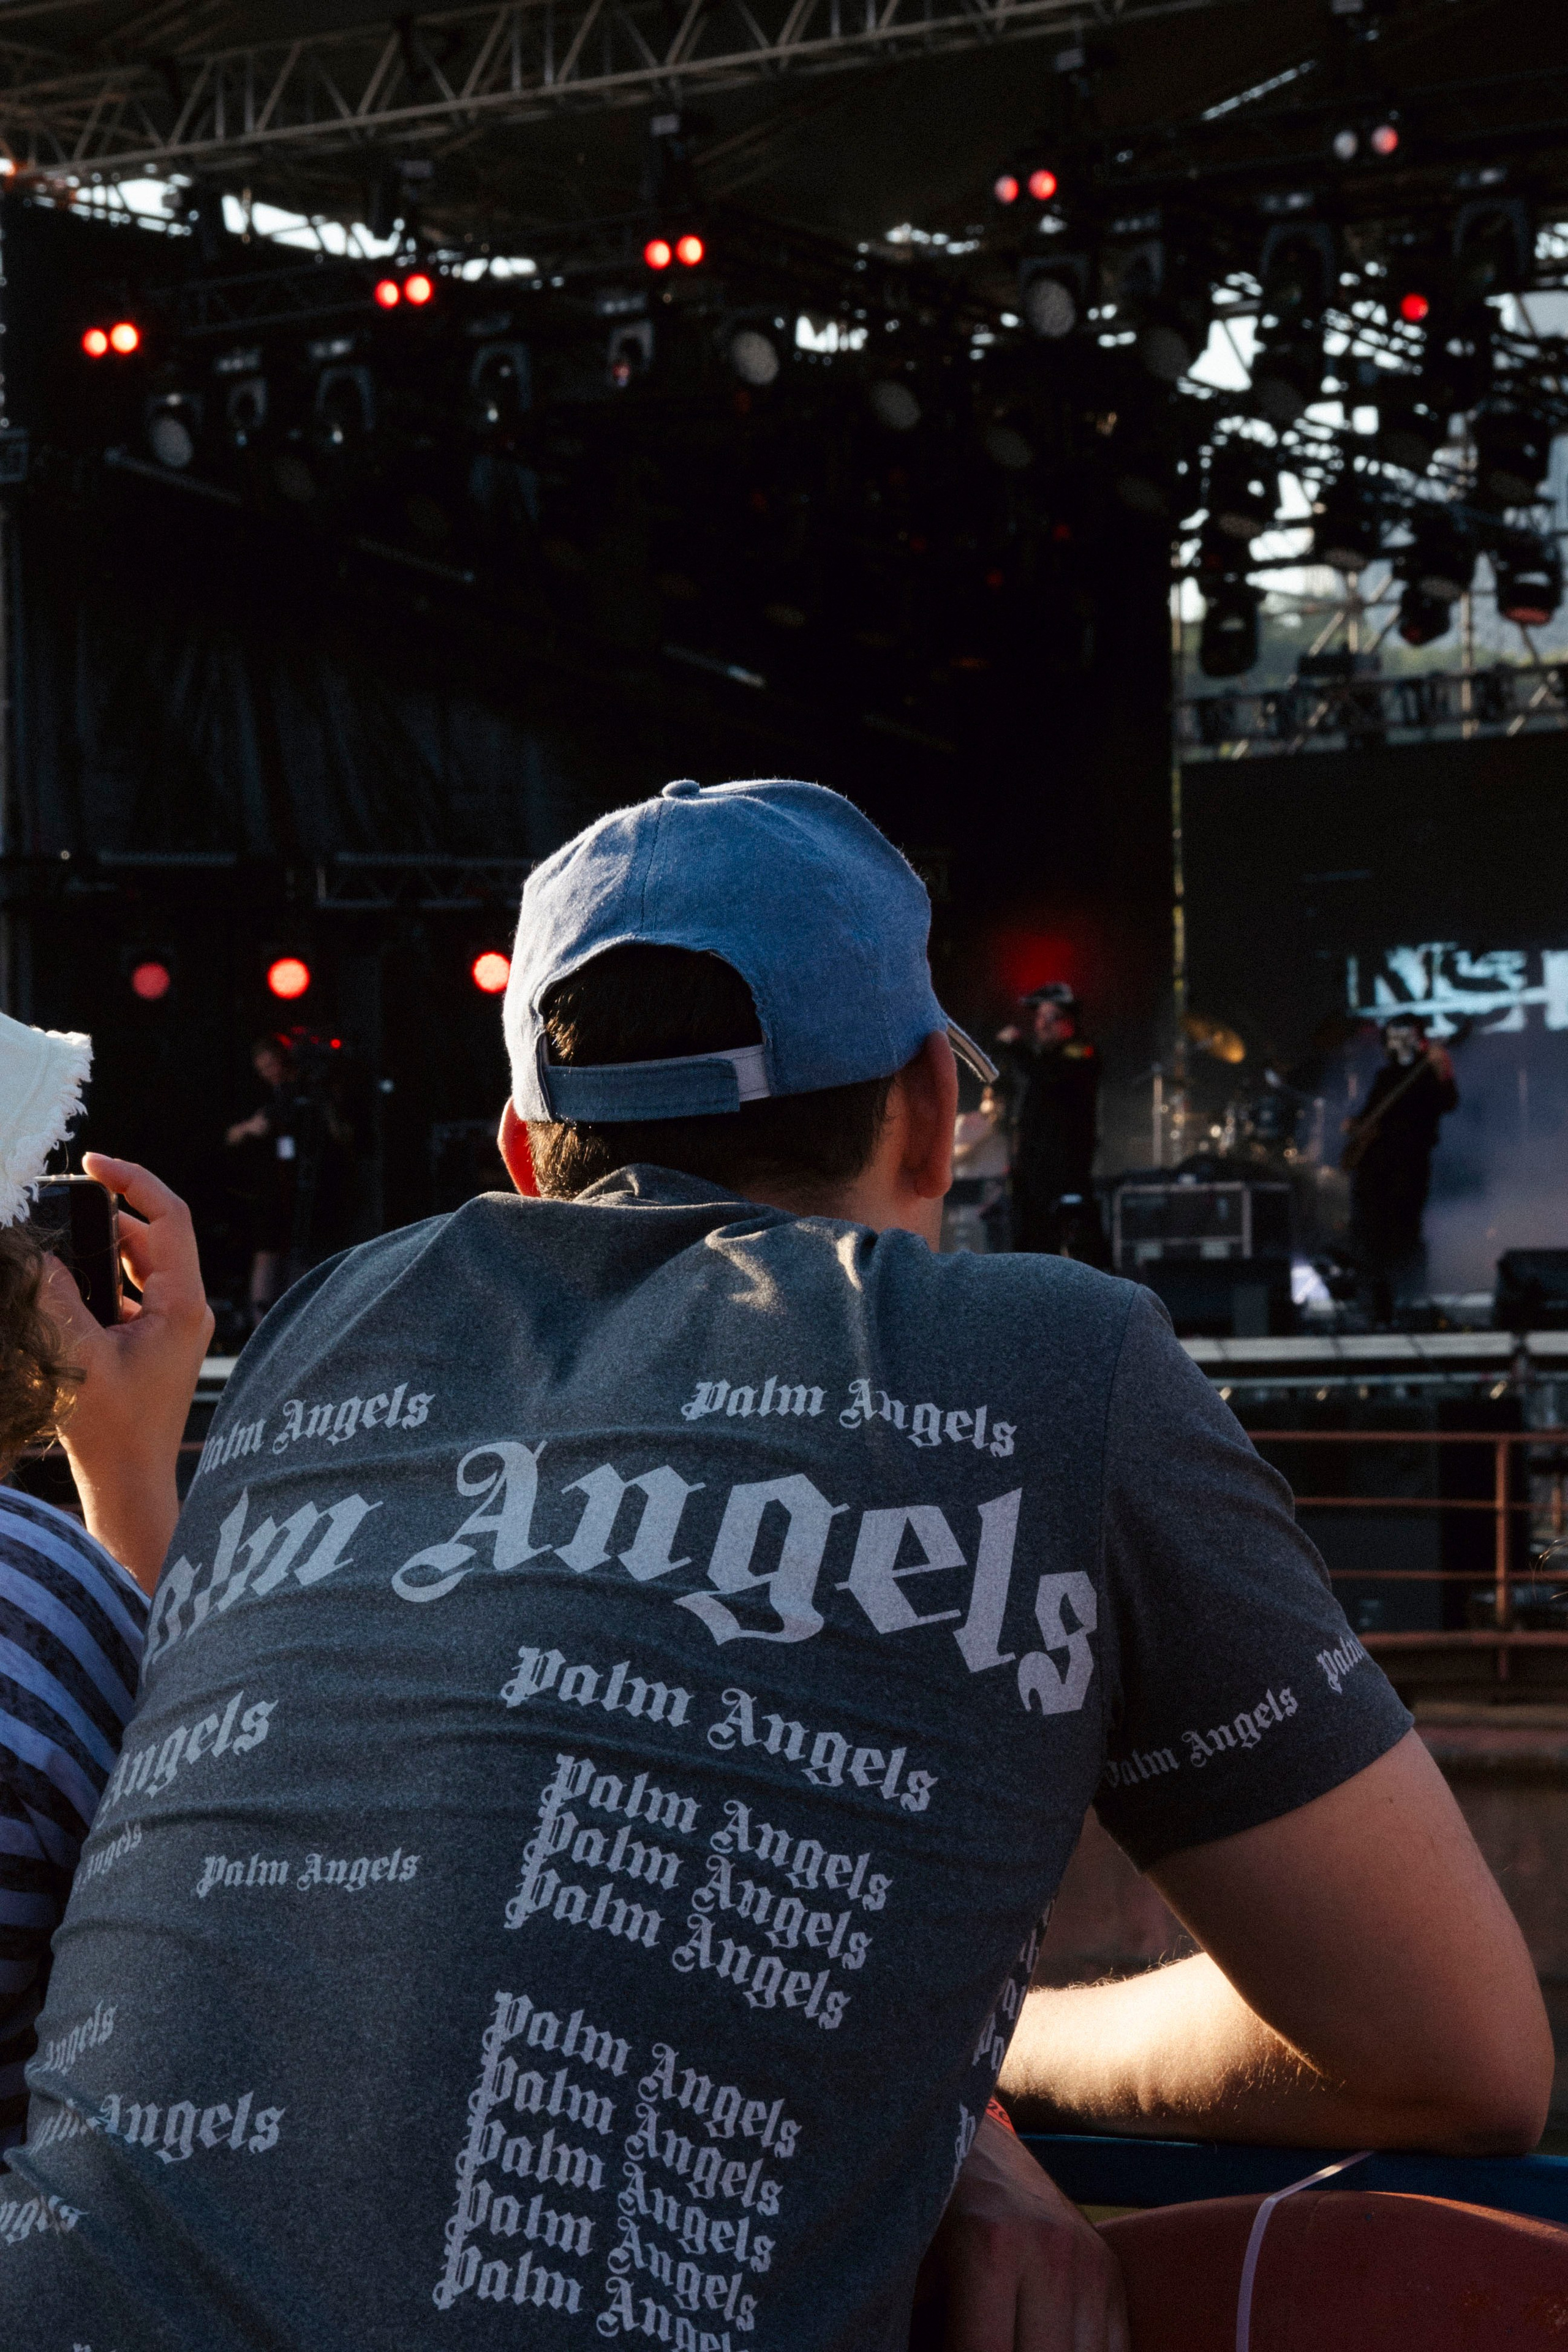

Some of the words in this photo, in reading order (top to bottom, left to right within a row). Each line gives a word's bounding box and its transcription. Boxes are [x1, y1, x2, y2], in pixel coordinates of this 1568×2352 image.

[195, 1419, 267, 1475] alm
[273, 1381, 435, 1454] Angels
[681, 1375, 827, 1421] Palm
[839, 1378, 1017, 1458] Angels
[141, 1485, 384, 1687] alm
[391, 1440, 1098, 1715] Angels
[500, 1645, 695, 1727] Palm
[707, 1687, 938, 1812] Angels
[1182, 1687, 1298, 1767] Angels
[197, 1852, 290, 1898] Palm
[297, 1847, 421, 1892] Angels
[523, 1806, 684, 1890] Palm
[692, 1854, 872, 1970] Angels
[541, 1753, 702, 1834] Palm
[710, 1800, 893, 1910] Angels
[503, 1862, 665, 1948] Palm
[672, 1913, 851, 2029] Angels
[86, 2090, 286, 2165] Angels
[467, 2052, 616, 2135] Palm
[625, 2102, 783, 2216] Angels
[482, 1989, 632, 2077] Palm
[638, 2043, 802, 2158] Angels
[445, 2174, 595, 2257] Palm
[607, 2215, 758, 2331] Angels
[454, 2113, 606, 2192] Palm
[617, 2162, 775, 2272] Angels
[432, 2241, 584, 2314] Palm
